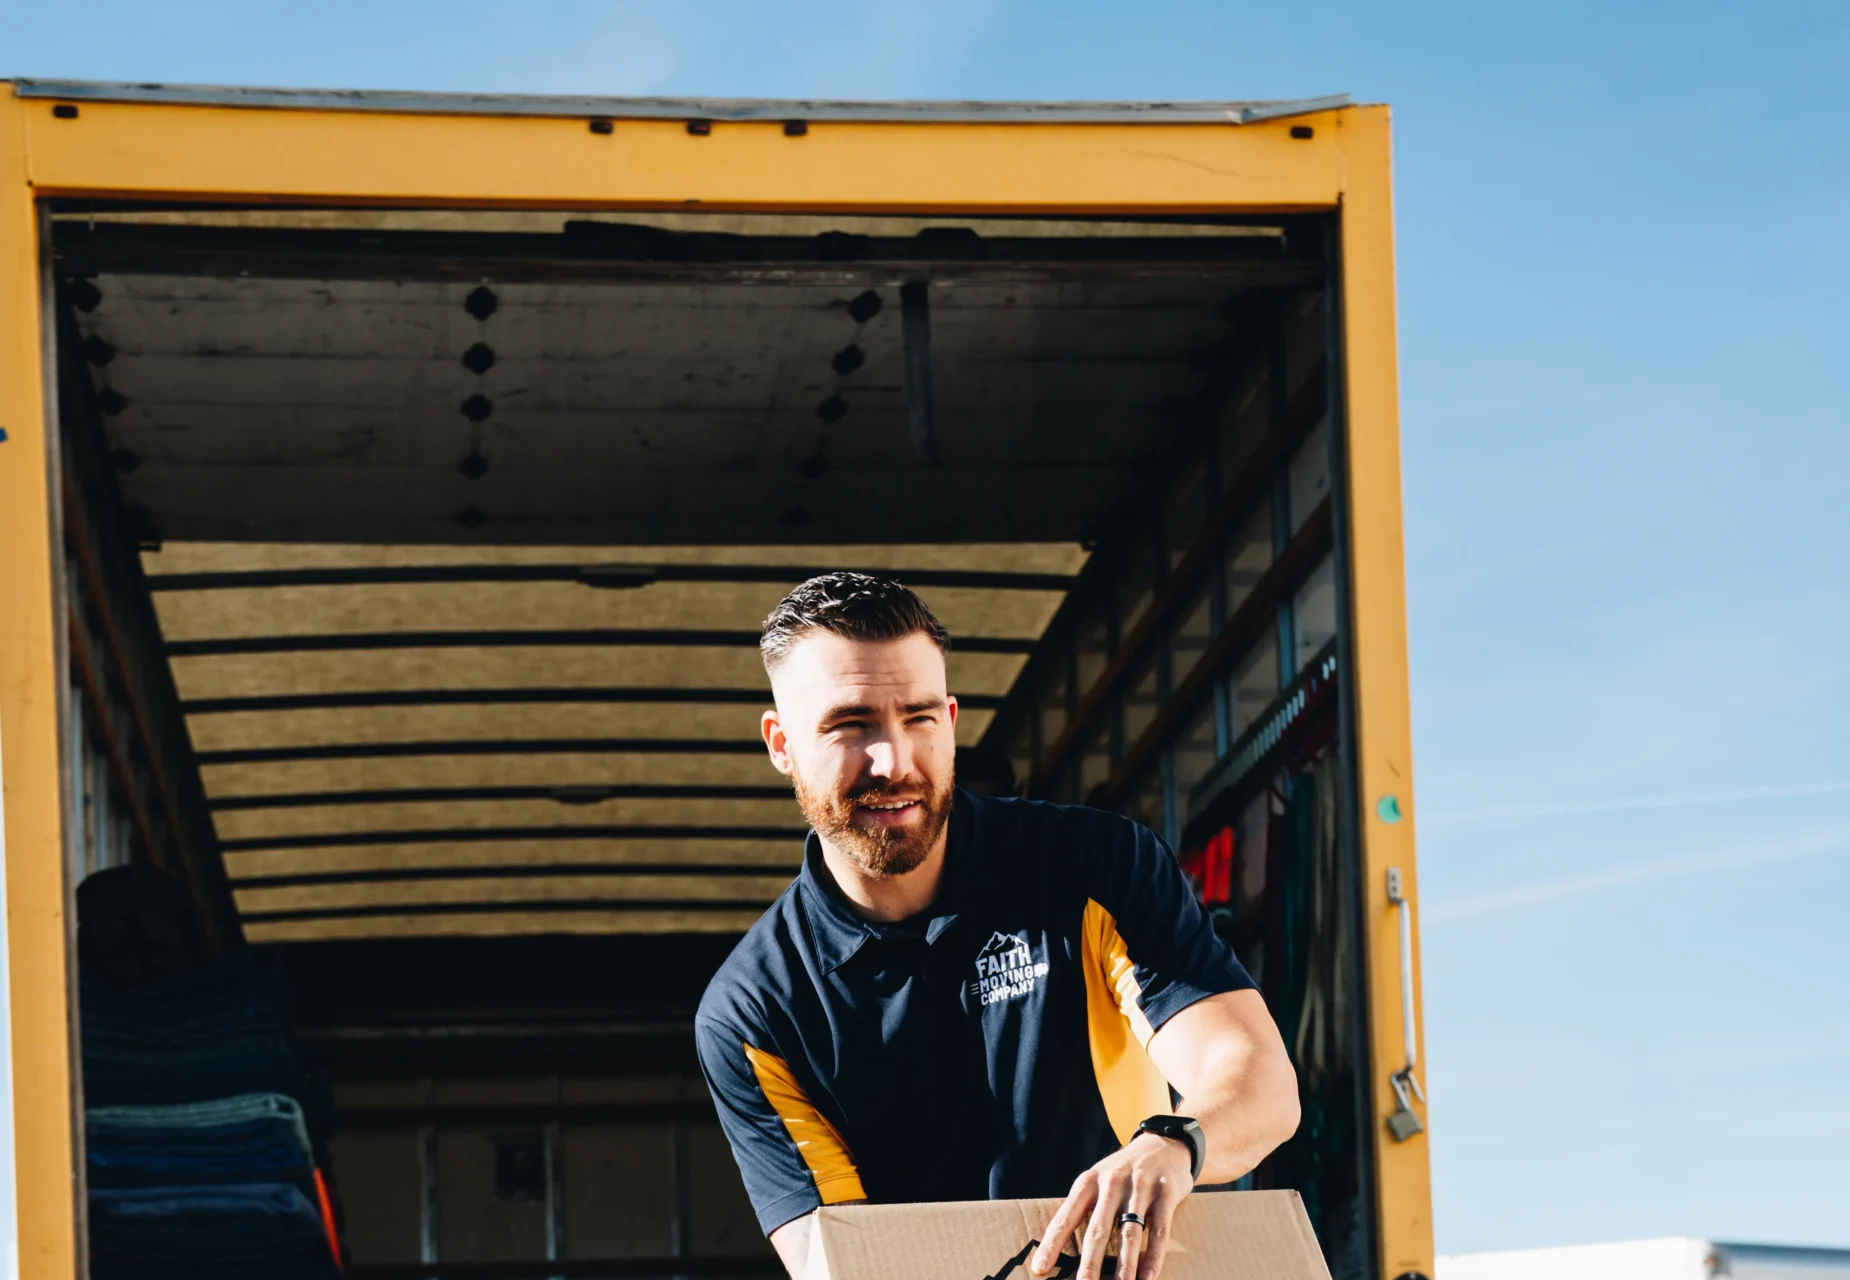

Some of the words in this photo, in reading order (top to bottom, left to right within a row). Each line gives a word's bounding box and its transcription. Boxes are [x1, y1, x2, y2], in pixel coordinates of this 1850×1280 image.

[975, 943, 1032, 979] FAITH
[979, 965, 1034, 994] MOVING
[980, 978, 1035, 1006] COMPANY
